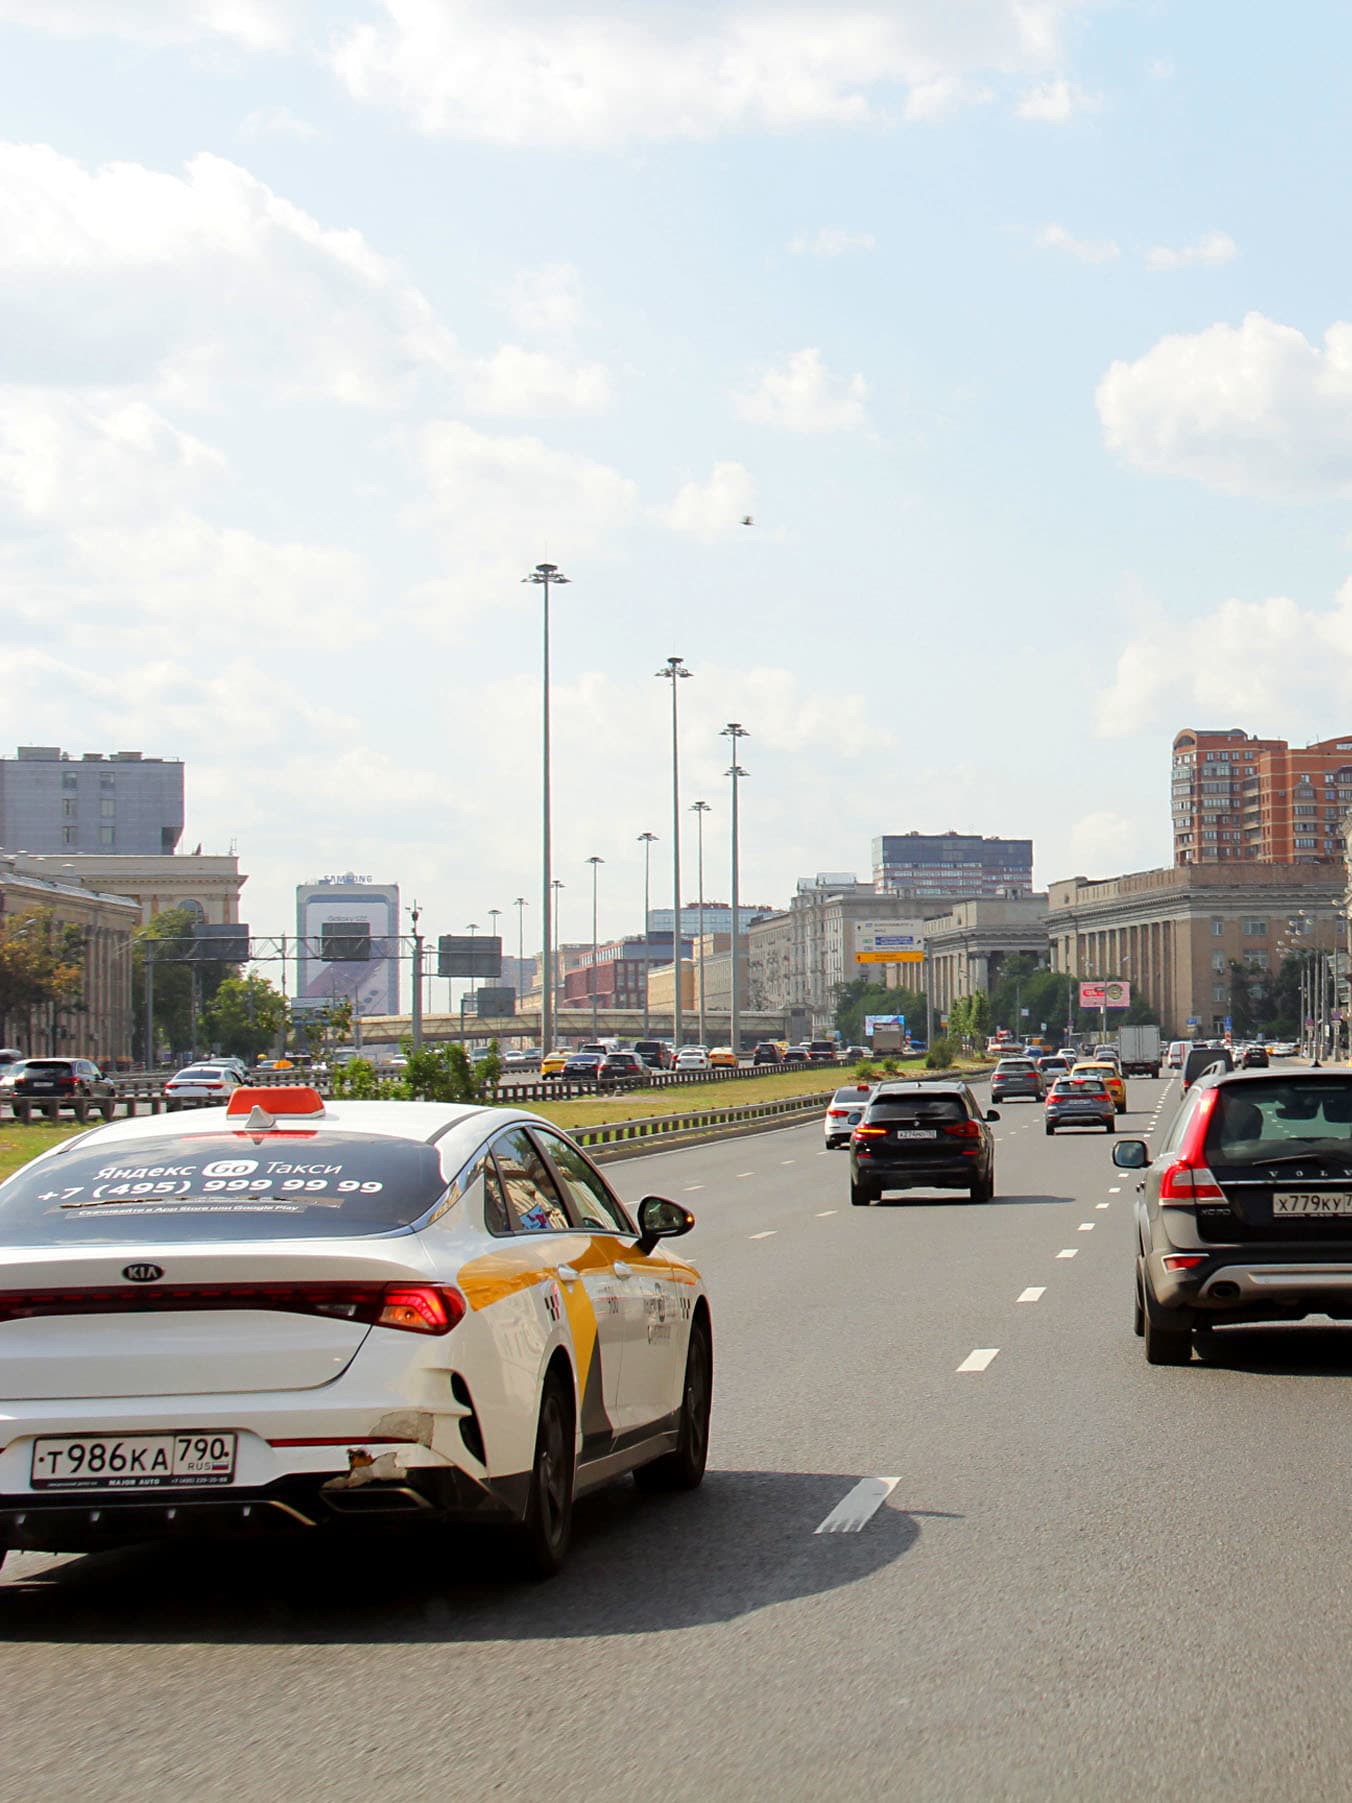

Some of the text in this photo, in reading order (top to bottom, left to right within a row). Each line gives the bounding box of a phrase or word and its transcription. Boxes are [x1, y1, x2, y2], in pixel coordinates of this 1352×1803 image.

[93, 1164, 197, 1181] Яндекс
[266, 1160, 343, 1175] Такси
[38, 1179, 383, 1201] +7 (495) 999 99 99
[155, 1206, 178, 1214] App
[180, 1205, 209, 1213] Store
[233, 1204, 274, 1213] Google
[276, 1203, 299, 1212] Play
[1278, 1195, 1342, 1212] Х779КУ
[128, 1267, 158, 1279] KIA
[47, 1438, 225, 1475] Т986КА 790
[187, 1462, 212, 1471] RUS
[139, 1478, 160, 1486] AUTO
